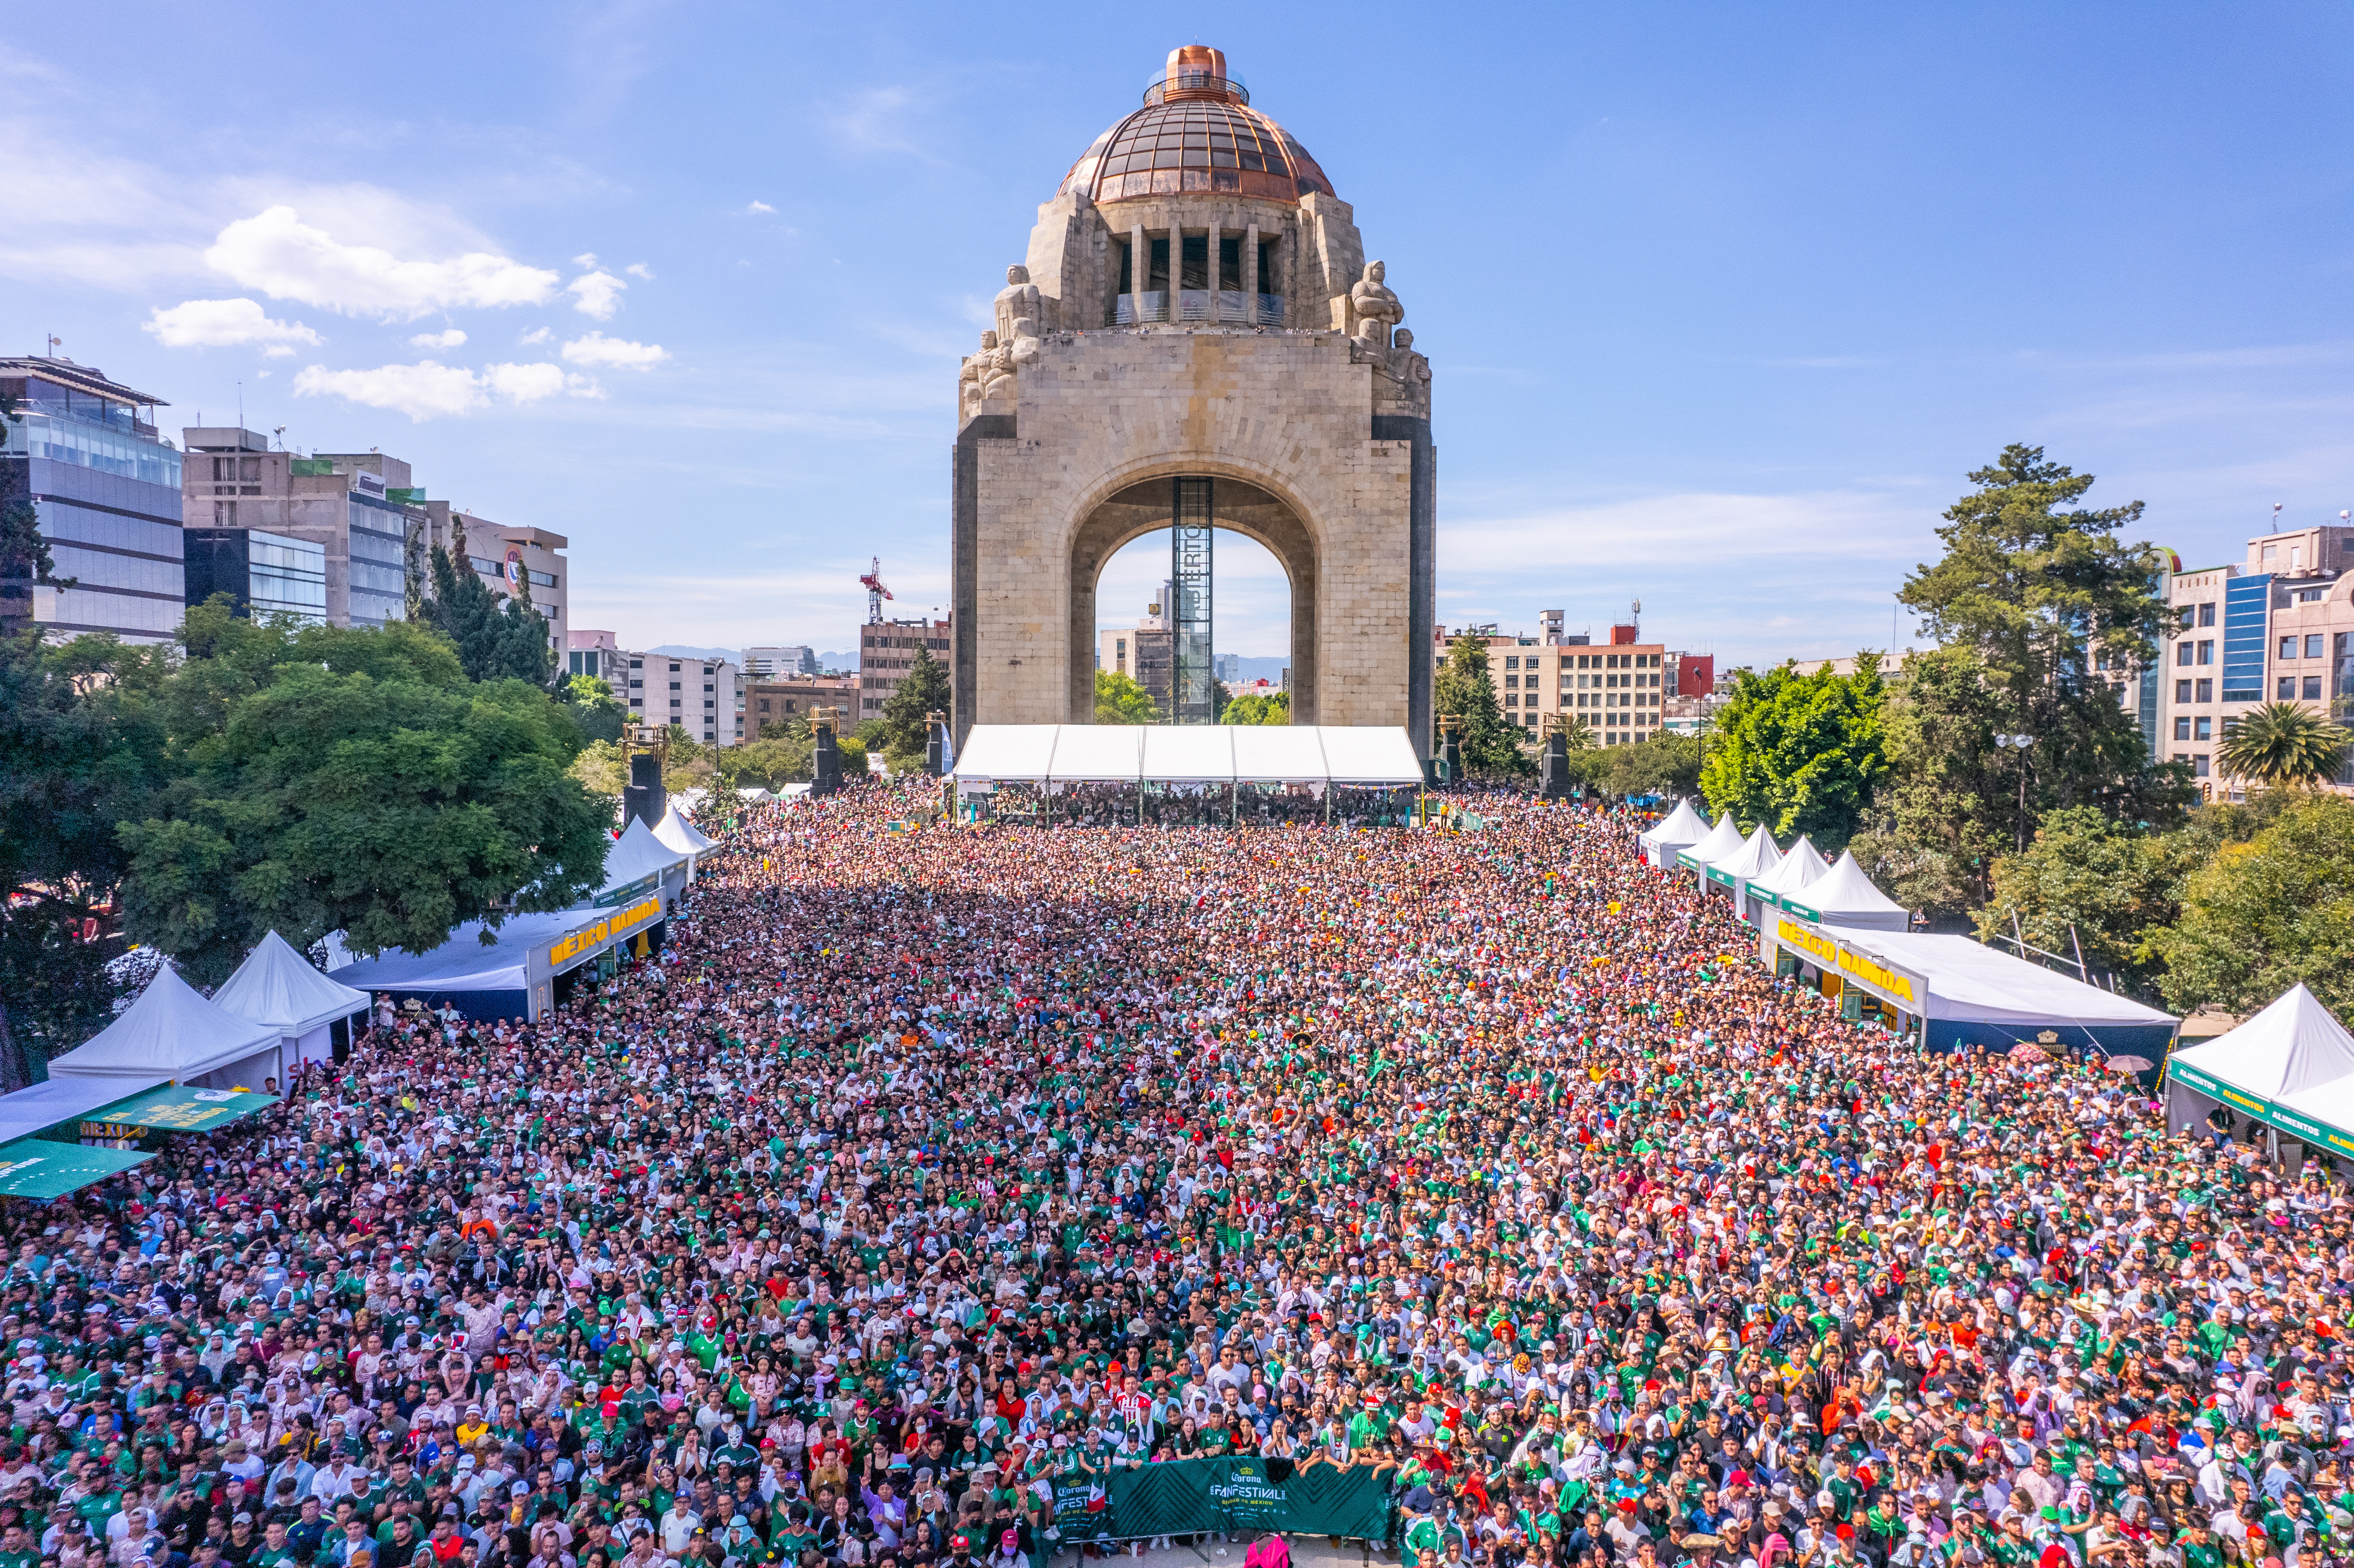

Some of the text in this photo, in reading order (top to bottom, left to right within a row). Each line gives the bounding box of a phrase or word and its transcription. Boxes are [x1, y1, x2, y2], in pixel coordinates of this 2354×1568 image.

[1183, 523, 1202, 621] ABIERTO
[551, 922, 608, 965] MÉXICO
[1778, 920, 1914, 1002] MÉXICO MANDA
[2179, 1068, 2217, 1092] ALIMENTOS
[2223, 1089, 2264, 1113] ALIMENTOS
[2272, 1111, 2320, 1136] ALIMENTOS
[264, 1272, 280, 1281] NIKE
[1058, 1485, 1090, 1497] Corona
[1231, 1472, 1261, 1483] Corona
